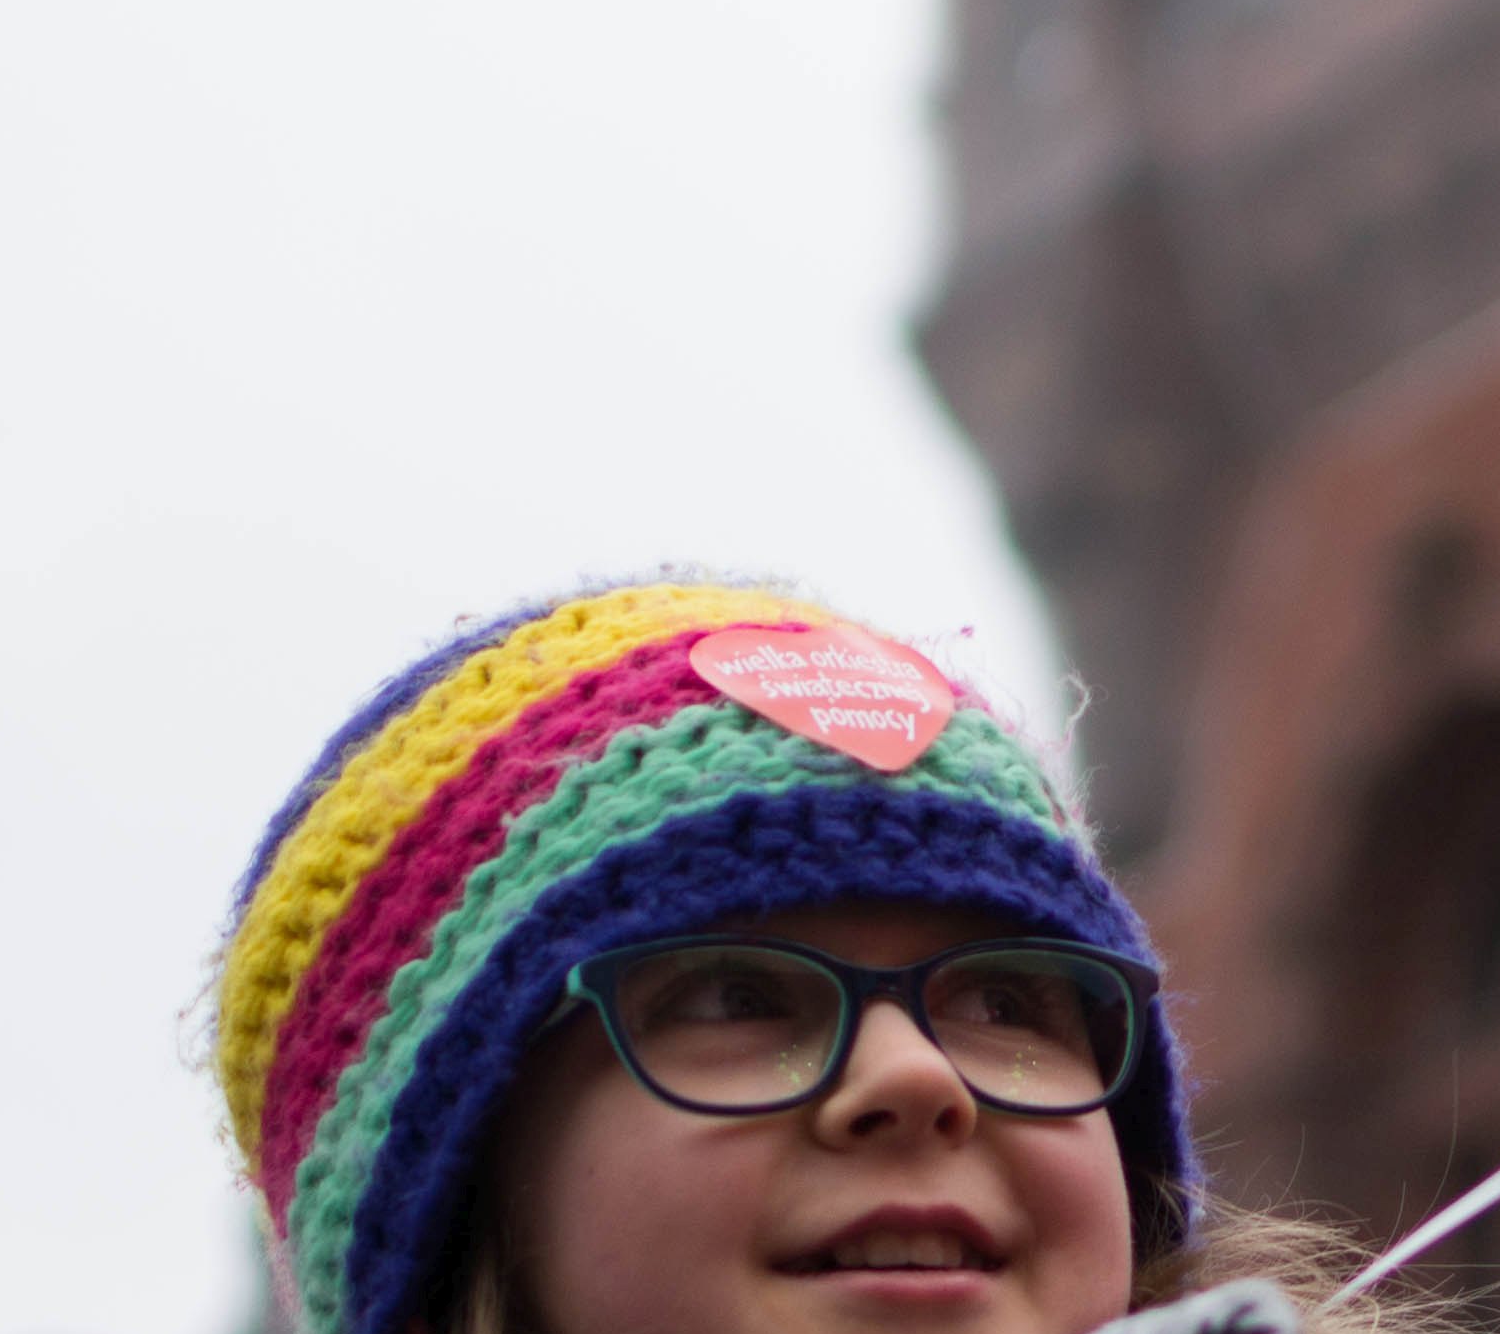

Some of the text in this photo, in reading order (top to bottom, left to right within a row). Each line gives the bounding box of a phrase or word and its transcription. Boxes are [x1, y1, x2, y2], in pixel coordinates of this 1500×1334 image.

[716, 644, 922, 681] wielka orkiestra
[808, 705, 917, 741] pomocy
